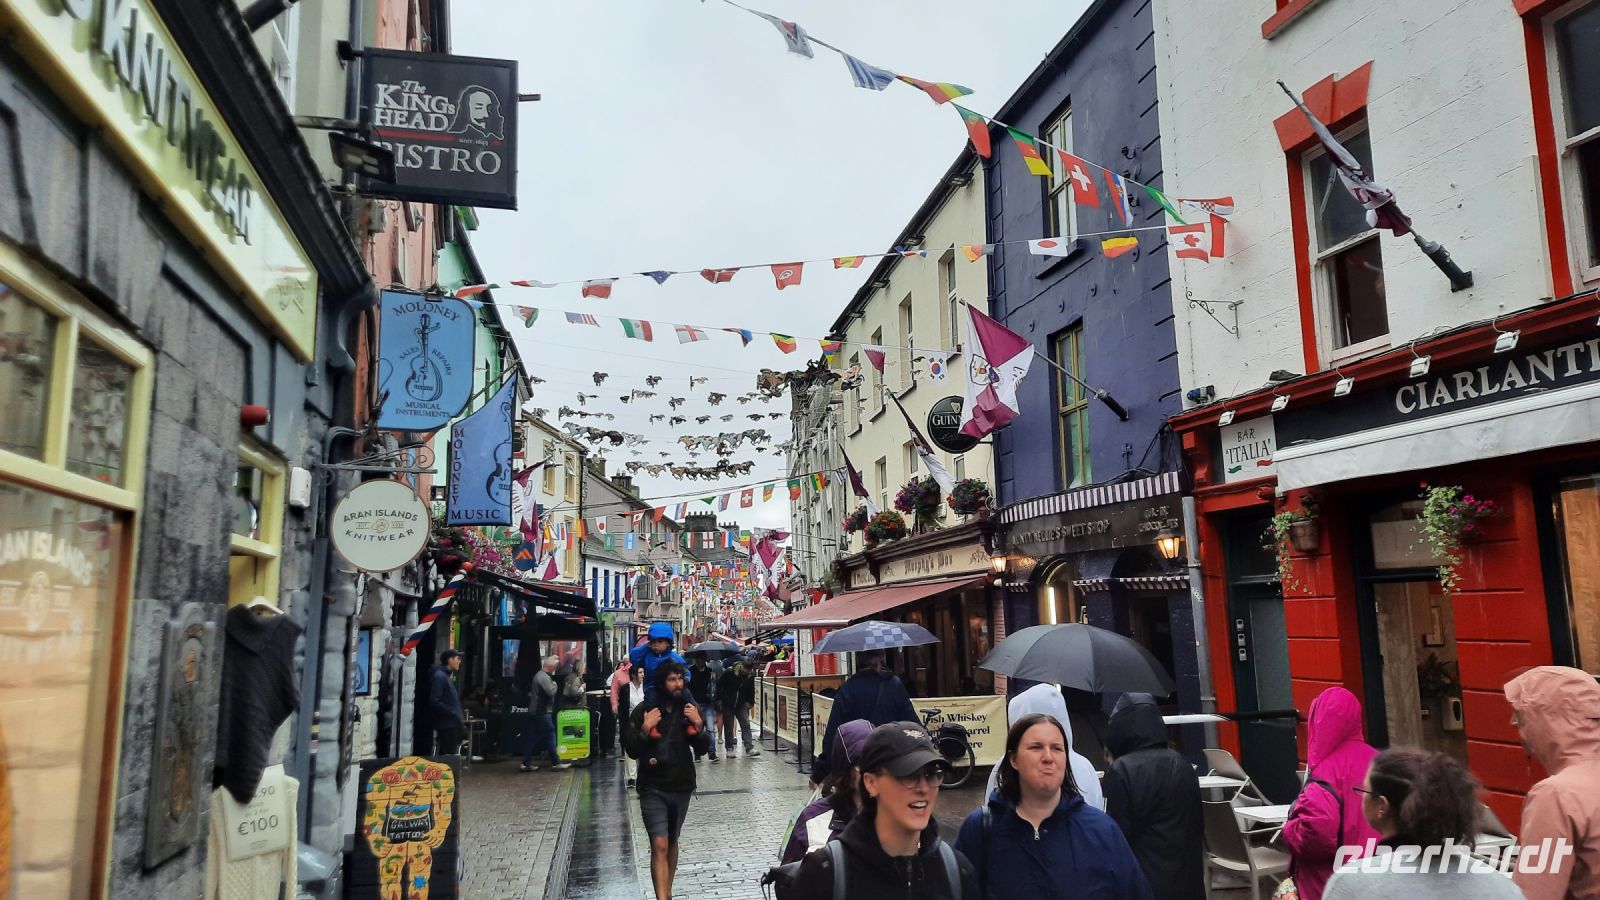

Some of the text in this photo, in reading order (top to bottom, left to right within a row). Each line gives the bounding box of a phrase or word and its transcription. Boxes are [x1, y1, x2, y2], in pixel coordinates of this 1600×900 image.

[401, 80, 427, 94] The
[374, 108, 449, 131] HEAD
[393, 302, 460, 321] MOLONEY
[399, 346, 420, 361] SALES
[431, 348, 453, 376] REPAIRS
[405, 402, 441, 410] MUSICAL
[395, 409, 450, 418] INSTRUMENTS
[1237, 428, 1255, 442] BAR
[452, 428, 464, 505] MOLONEY
[343, 509, 418, 523] ARAN ISLANDS
[451, 508, 500, 520] MUSIC
[1088, 519, 1111, 534] SHOP
[345, 528, 415, 541] KNITWEAR
[511, 705, 529, 713] Free
[947, 713, 987, 723] Whiskey
[238, 814, 279, 836] €100
[391, 818, 429, 830] GALWAY
[390, 830, 426, 840] TATTOOS
